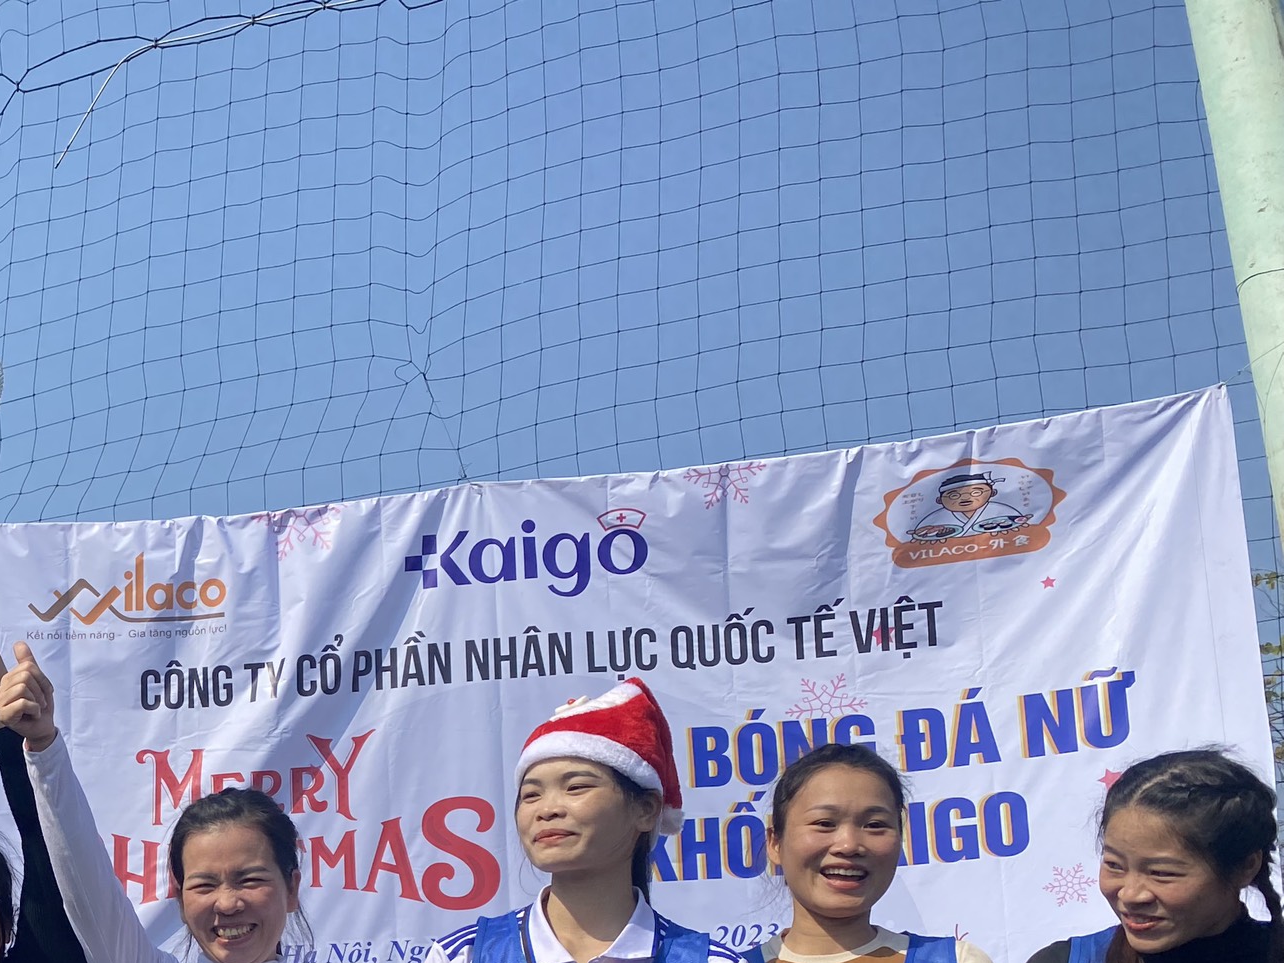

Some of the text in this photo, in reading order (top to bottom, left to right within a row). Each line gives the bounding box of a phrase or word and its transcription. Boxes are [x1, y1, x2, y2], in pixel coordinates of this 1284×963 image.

[405, 519, 649, 597] Kaigo
[26, 630, 44, 641] Kết
[47, 629, 63, 641] nối
[89, 629, 115, 642] năng
[128, 629, 146, 639] Gia
[149, 627, 172, 640] tăng
[139, 595, 943, 711] CÔNG TY CỔ PHẦN NHÂN LỰC QUỐC TẾ VIỆT
[894, 686, 1002, 773] ĐÁ
[1017, 666, 1136, 758] NỮ
